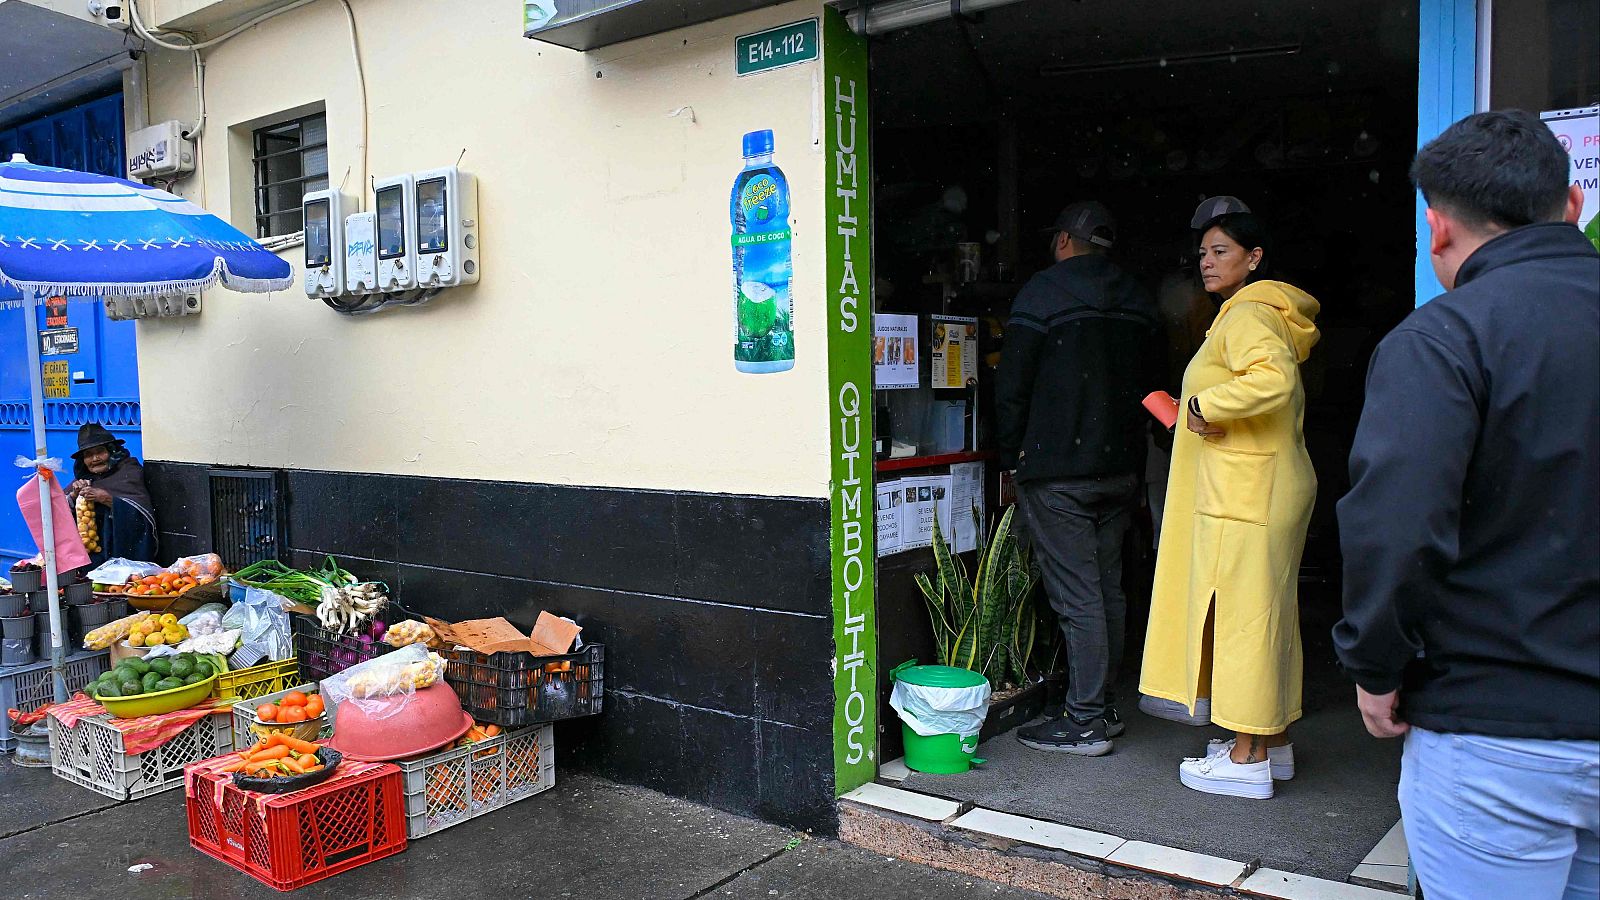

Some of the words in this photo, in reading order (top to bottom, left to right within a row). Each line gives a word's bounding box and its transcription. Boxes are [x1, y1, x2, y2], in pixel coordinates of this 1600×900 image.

[749, 33, 804, 63] E14-112
[745, 178, 769, 197] Coco
[834, 75, 860, 333] HUMITAS
[738, 235, 756, 244] AGUA
[757, 234, 766, 242] DE
[768, 232, 785, 240] COCO
[838, 381, 865, 765] QUIMBOLITOS
